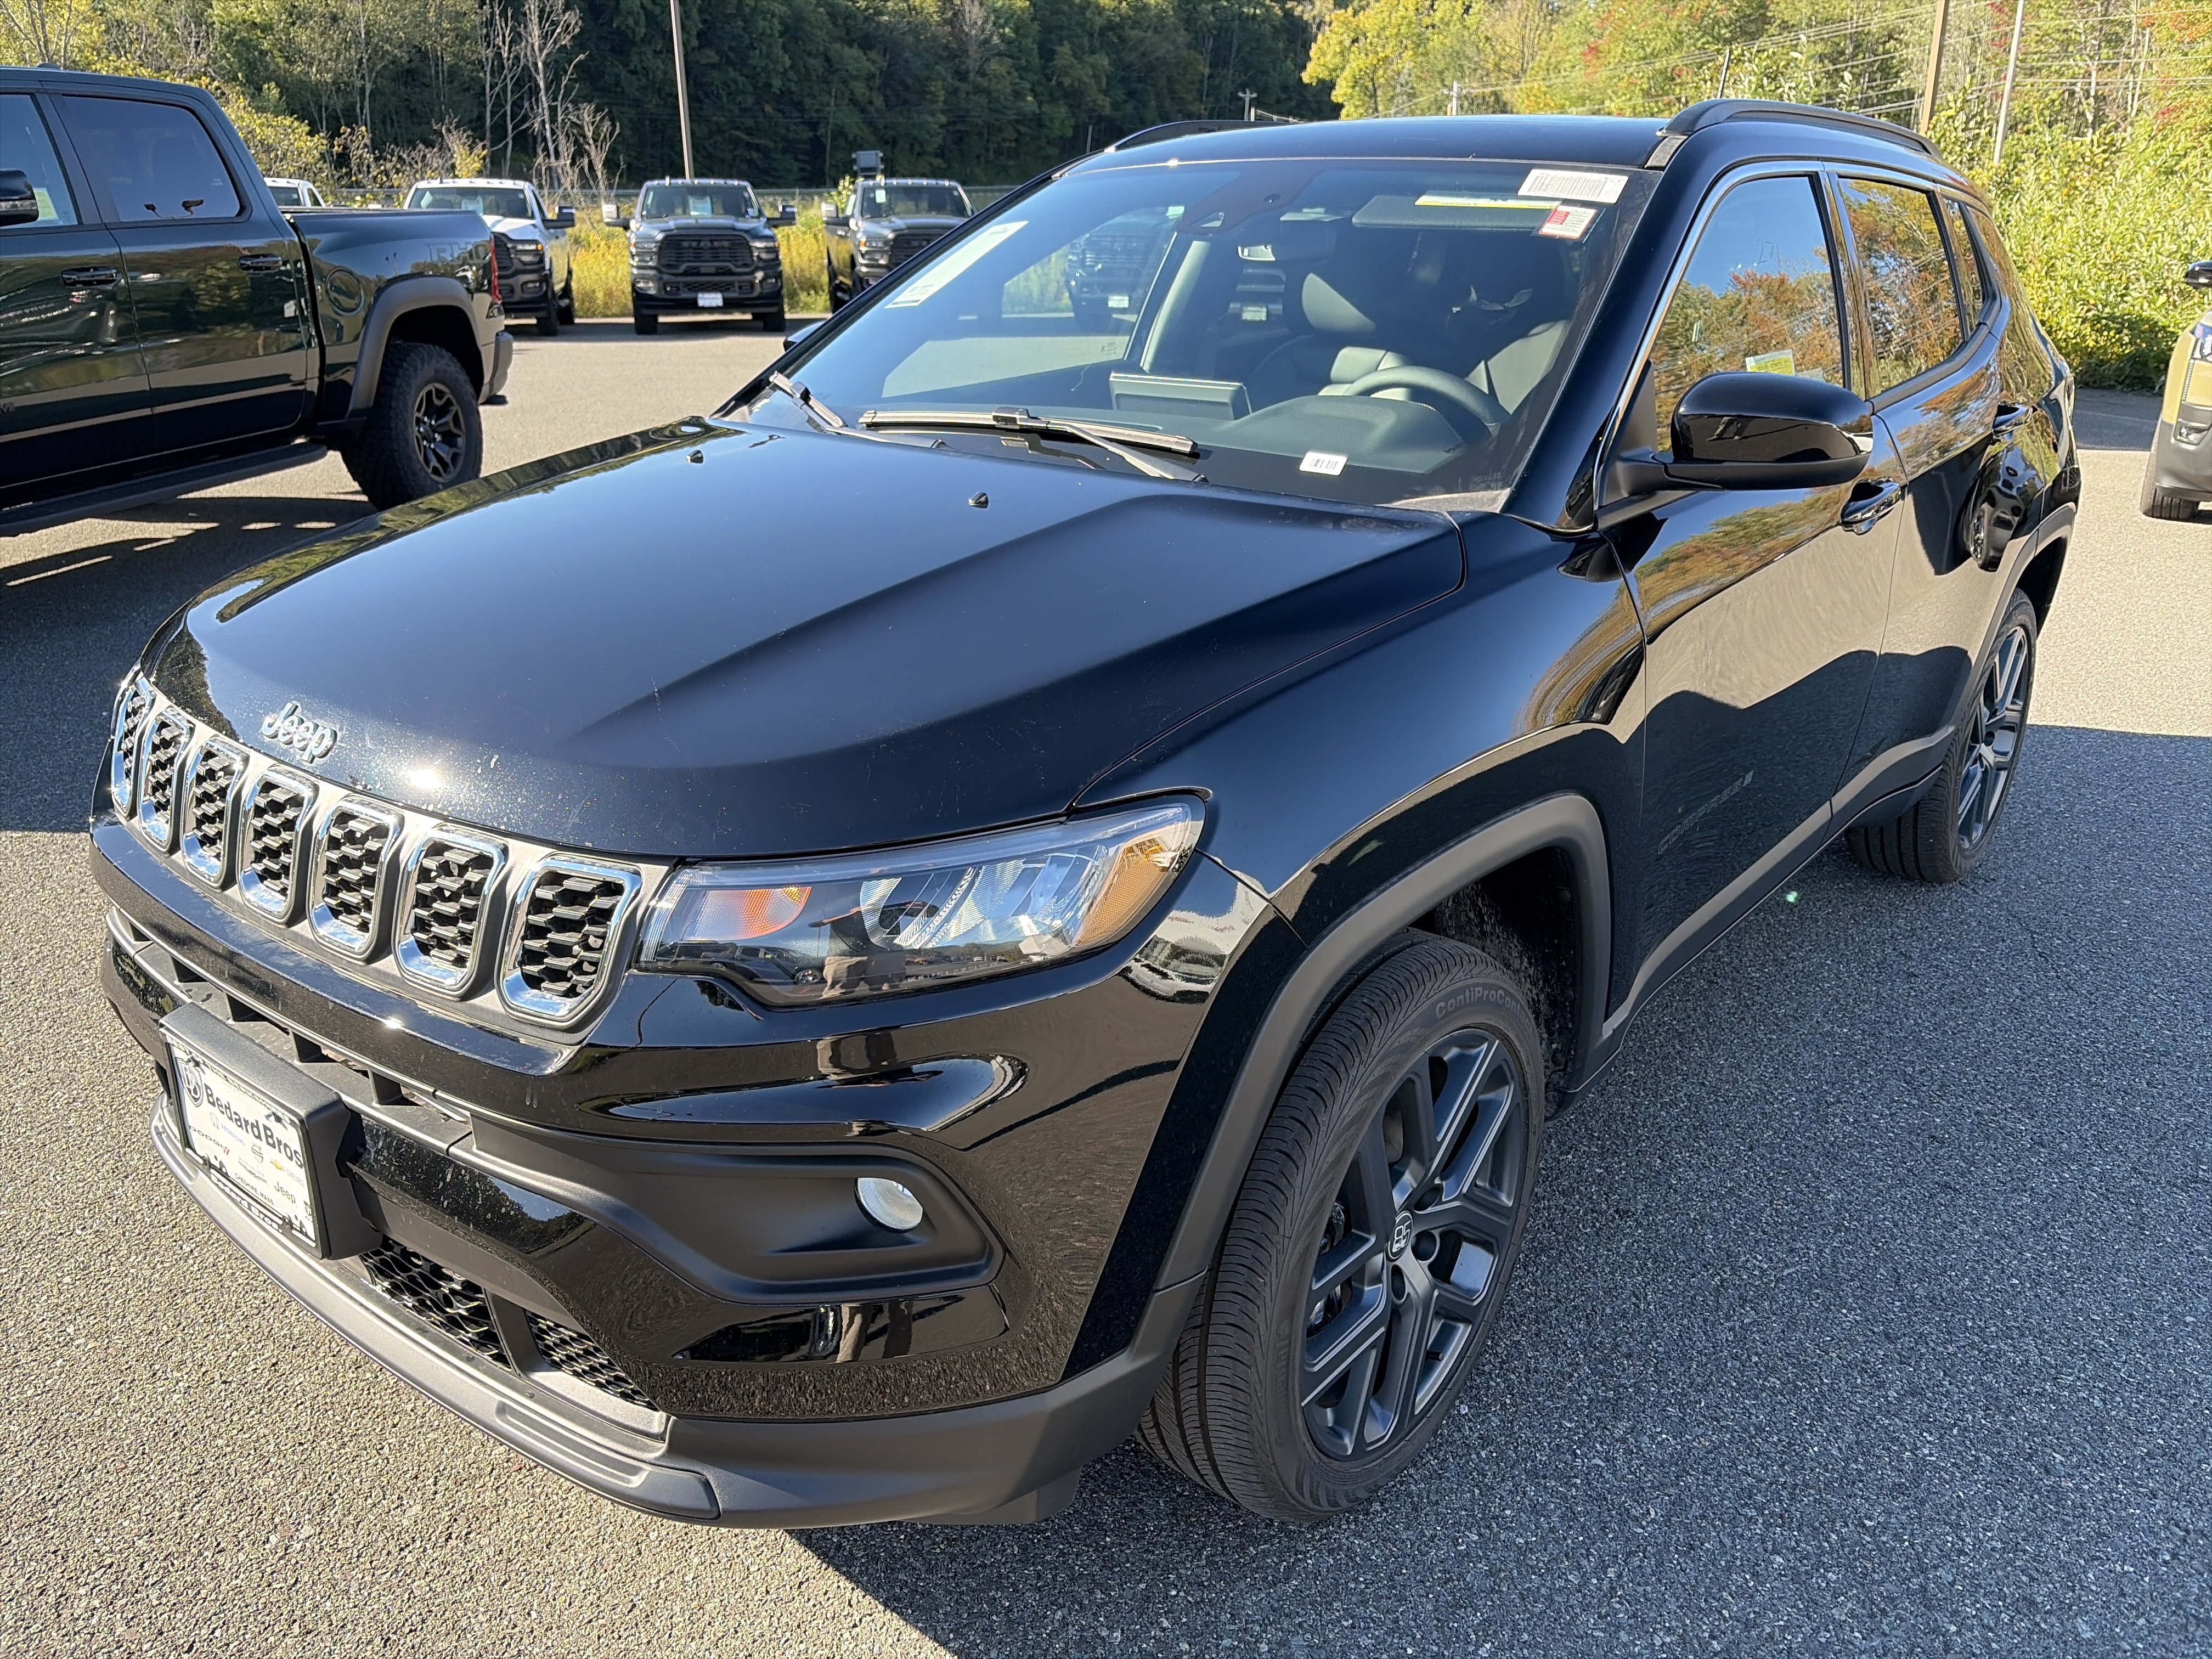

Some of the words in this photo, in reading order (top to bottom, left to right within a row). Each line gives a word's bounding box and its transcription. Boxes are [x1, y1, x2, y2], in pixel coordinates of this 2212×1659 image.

[261, 702, 338, 764] Jeep
[1657, 776, 1744, 855] COMPASS
[204, 1083, 262, 1142] Bedard
[262, 1122, 303, 1169] Bros
[210, 1173, 249, 1209] Bedard
[274, 1181, 296, 1204] Jeep
